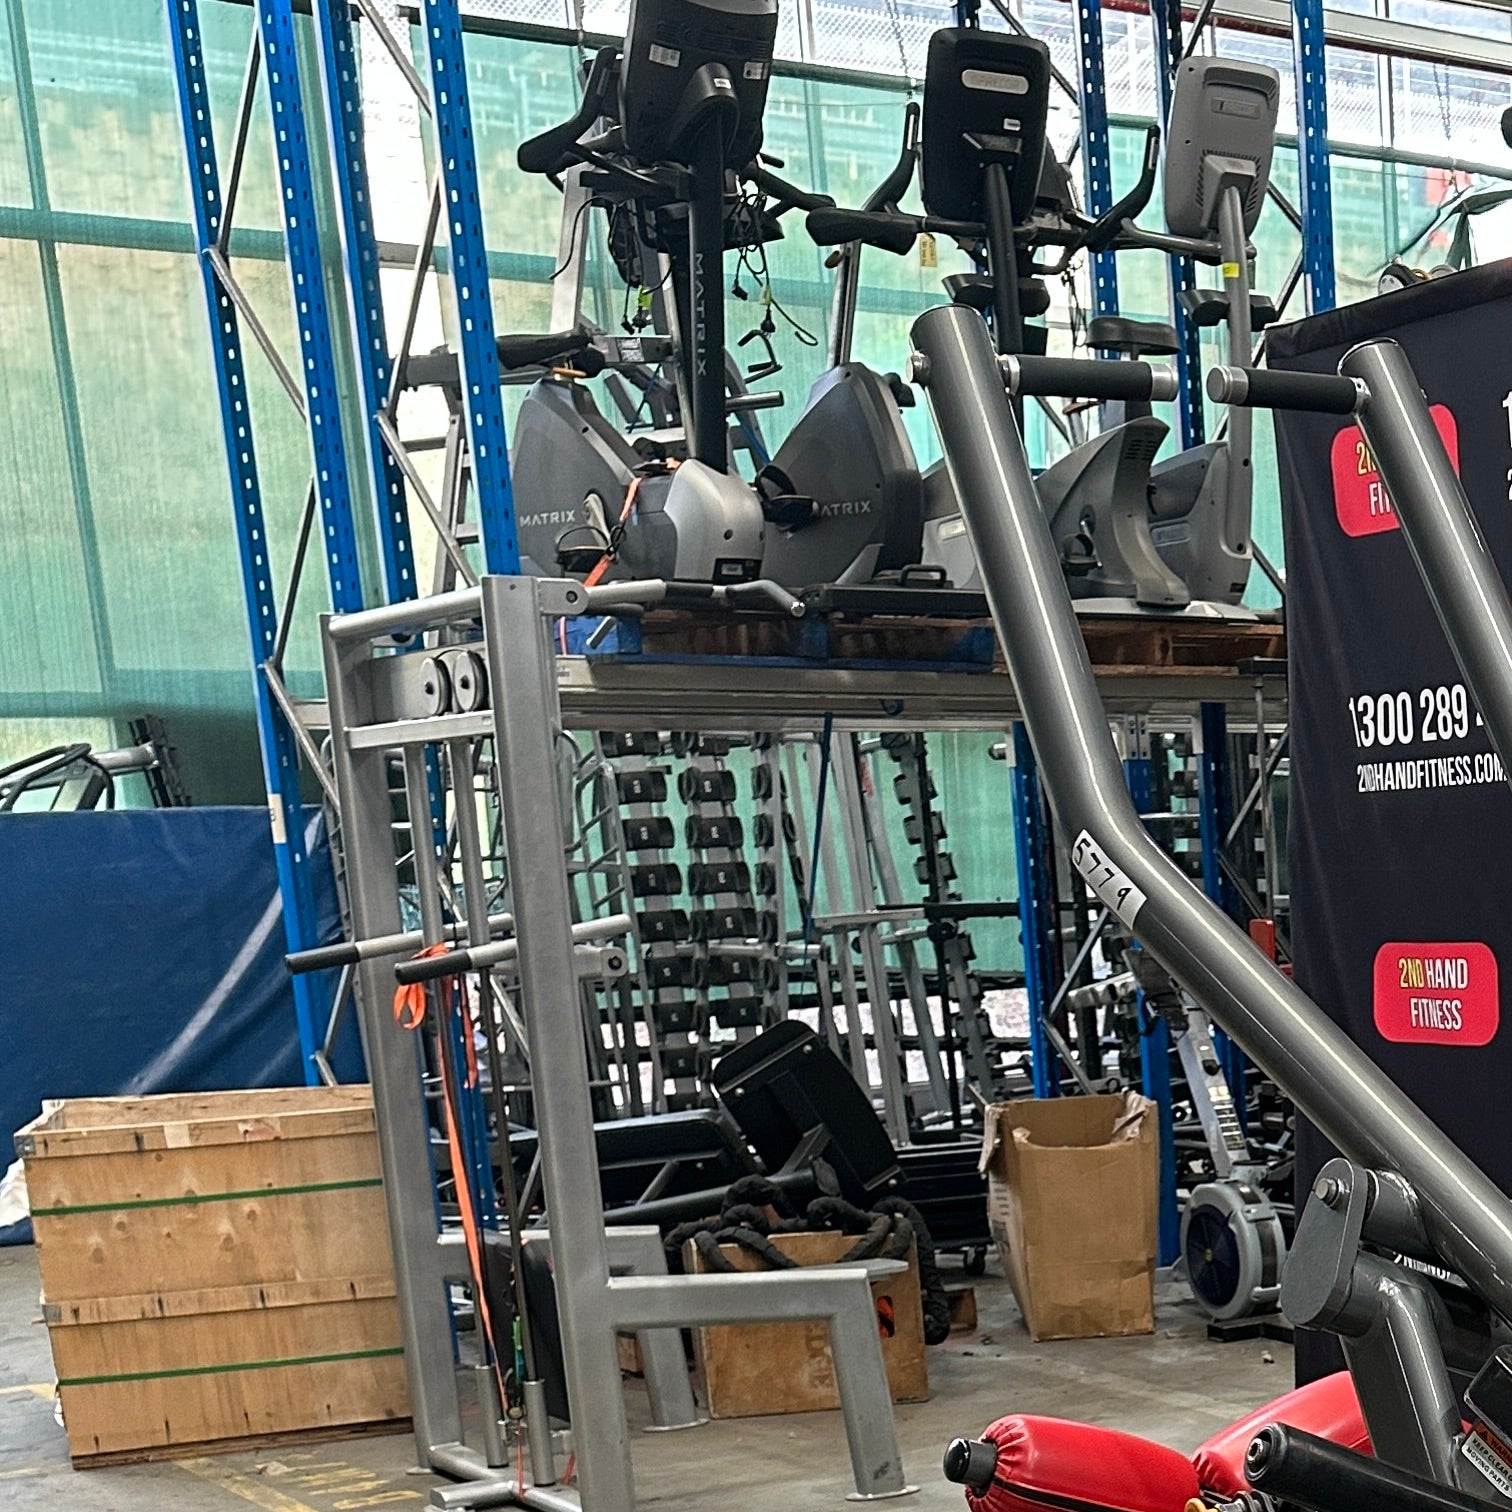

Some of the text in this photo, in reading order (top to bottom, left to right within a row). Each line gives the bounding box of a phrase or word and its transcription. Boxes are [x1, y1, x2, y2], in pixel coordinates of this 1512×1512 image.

[695, 252, 707, 376] MATRIX
[519, 509, 577, 528] MATRIX
[820, 500, 873, 518] ATRIX
[1348, 683, 1469, 747] 1300 289
[1399, 958, 1467, 989] 2ND HAND
[1410, 997, 1462, 1030] FITNESS
[1466, 1446, 1511, 1492] MOVING PARTS
[1488, 1454, 1509, 1477] CLEAR
